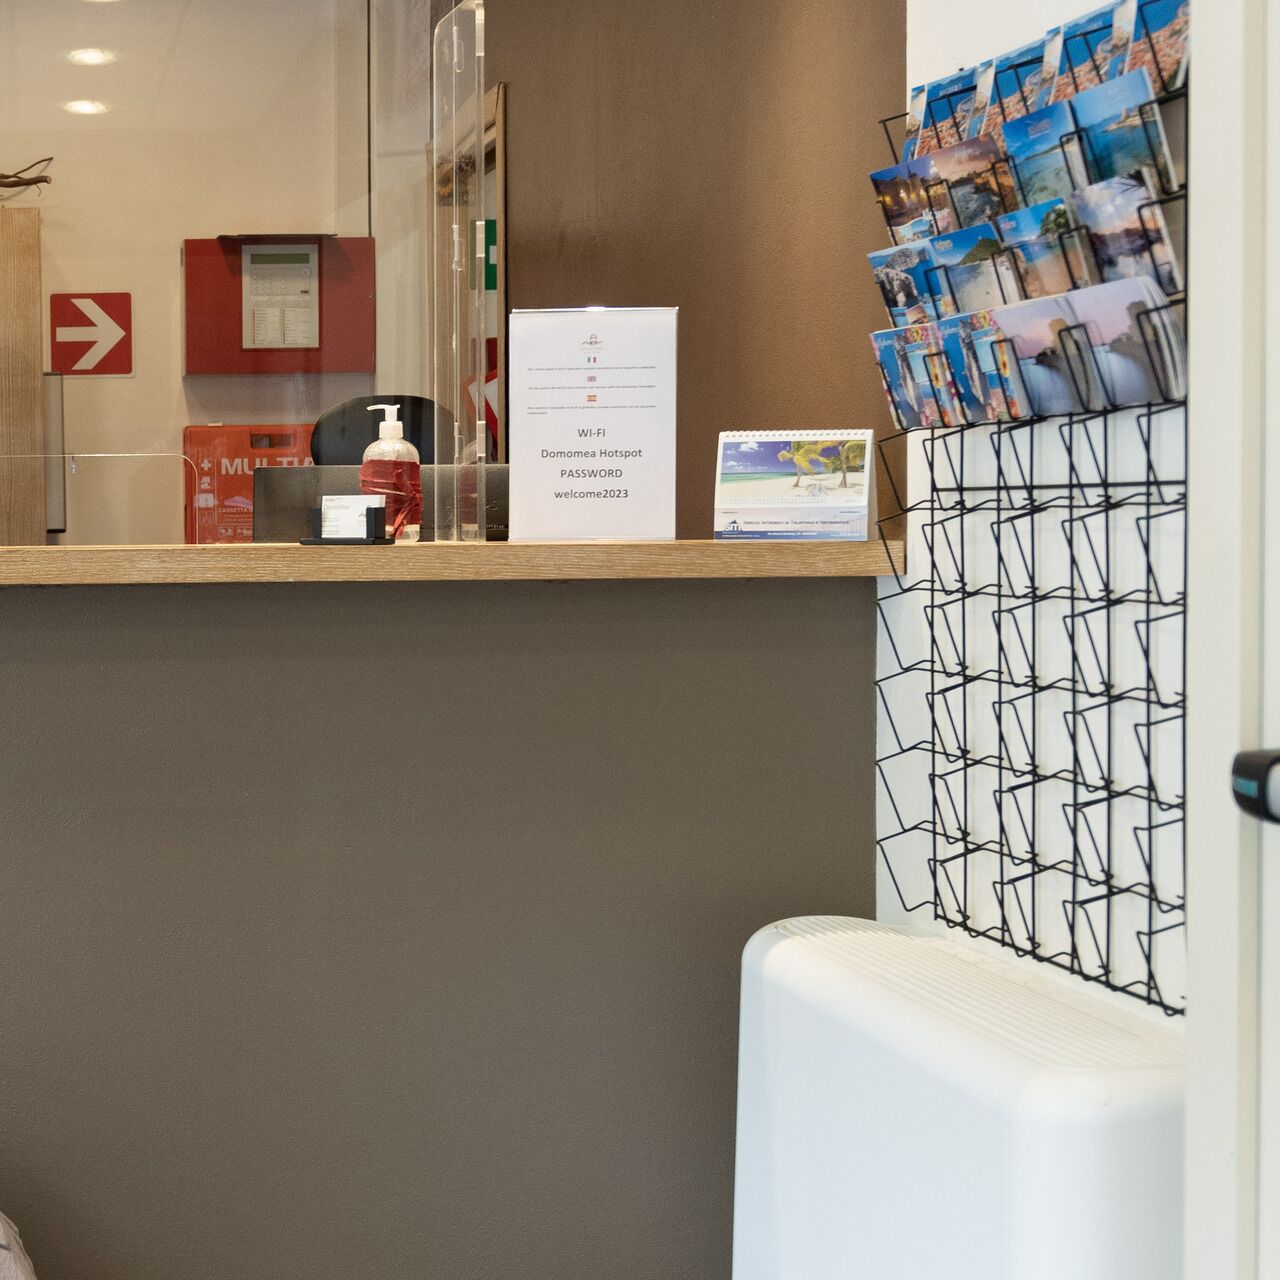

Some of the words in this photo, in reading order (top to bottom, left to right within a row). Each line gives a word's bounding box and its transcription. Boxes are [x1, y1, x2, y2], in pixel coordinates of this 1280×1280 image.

[577, 428, 606, 438] WI-FI
[541, 449, 596, 458] Domomea
[599, 449, 643, 459] Hotspot
[560, 469, 623, 478] PASSWORD
[554, 489, 629, 499] welcome2023
